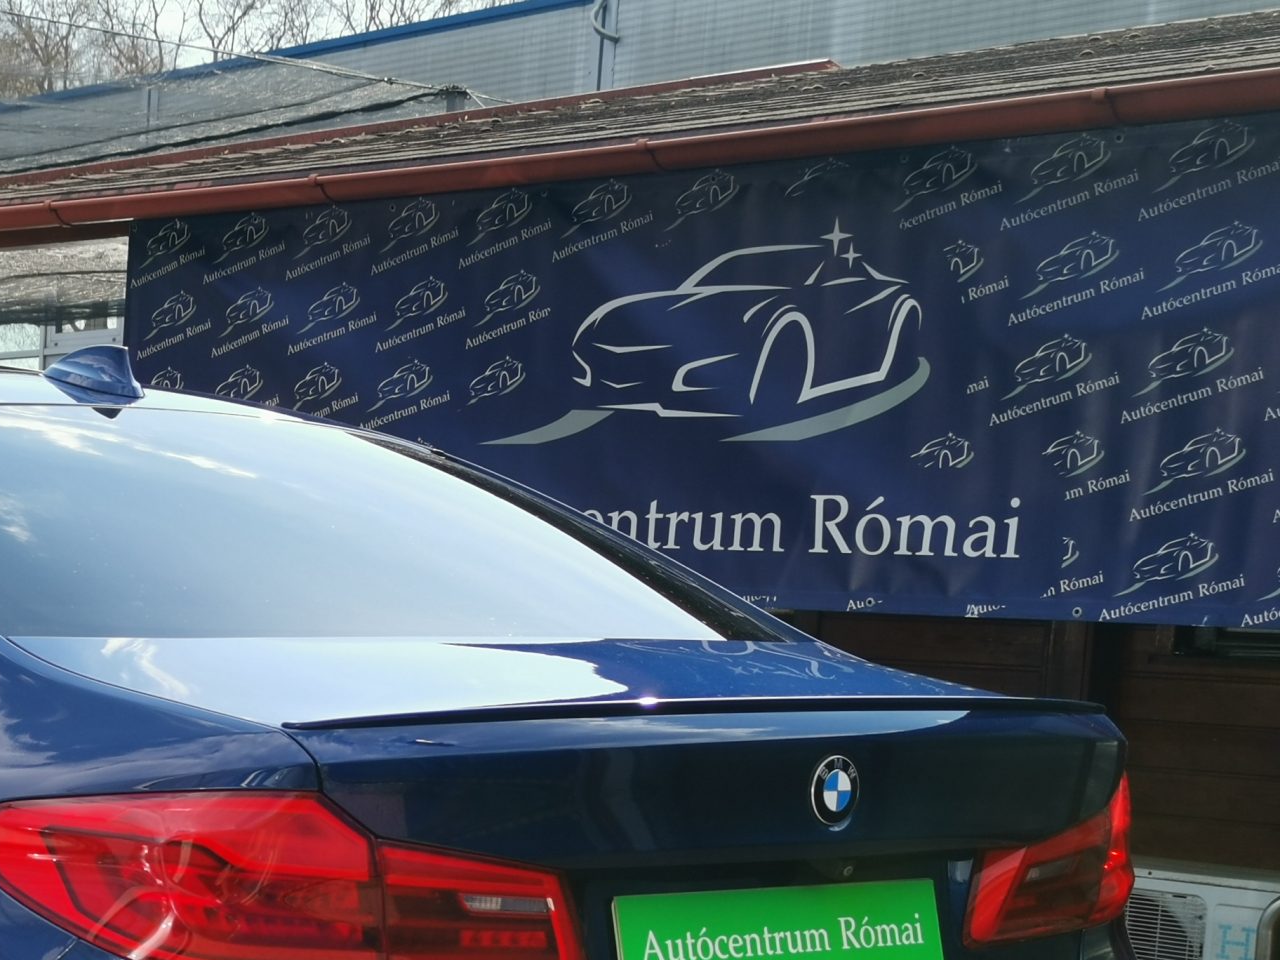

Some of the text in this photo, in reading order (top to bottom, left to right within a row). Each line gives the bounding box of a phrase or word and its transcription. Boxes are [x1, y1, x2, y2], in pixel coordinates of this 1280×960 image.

[899, 180, 1003, 230] ócentrum Római
[1000, 169, 1139, 231] Autócentrum Római
[1138, 156, 1280, 221] Autócentrum Róma
[285, 233, 370, 281] Autócentrum Római
[370, 226, 460, 276] Autócentrum Római
[458, 218, 552, 270] Autócentrum Római
[552, 210, 654, 263] Autócentrum Római
[130, 247, 205, 289] Autócentrum Római
[202, 240, 286, 285] Autócentrum Római
[968, 275, 1009, 300] Római
[1007, 268, 1145, 326] Autócentrum Római
[1141, 263, 1280, 320] Autócentrum Róma
[136, 319, 212, 361] Autócentrum Római
[211, 315, 289, 358] Autócentrum Római
[287, 312, 377, 356] Autócentrum Római
[375, 306, 466, 353] Autócentrum Római
[465, 306, 552, 350] Autócentrum Róm
[332, 393, 359, 411] Római
[420, 390, 450, 411] Római
[966, 376, 990, 394] mai
[988, 372, 1120, 426] Autócentrum Római
[1120, 367, 1264, 424] Autócentrum Római
[1087, 470, 1130, 494] Római
[1128, 469, 1274, 522] Autócentrum Római
[808, 494, 1021, 558] Római
[1059, 570, 1104, 593] Római
[1098, 574, 1245, 622] Autócentrum Római
[818, 758, 857, 780] BMW
[837, 912, 924, 950] Római
